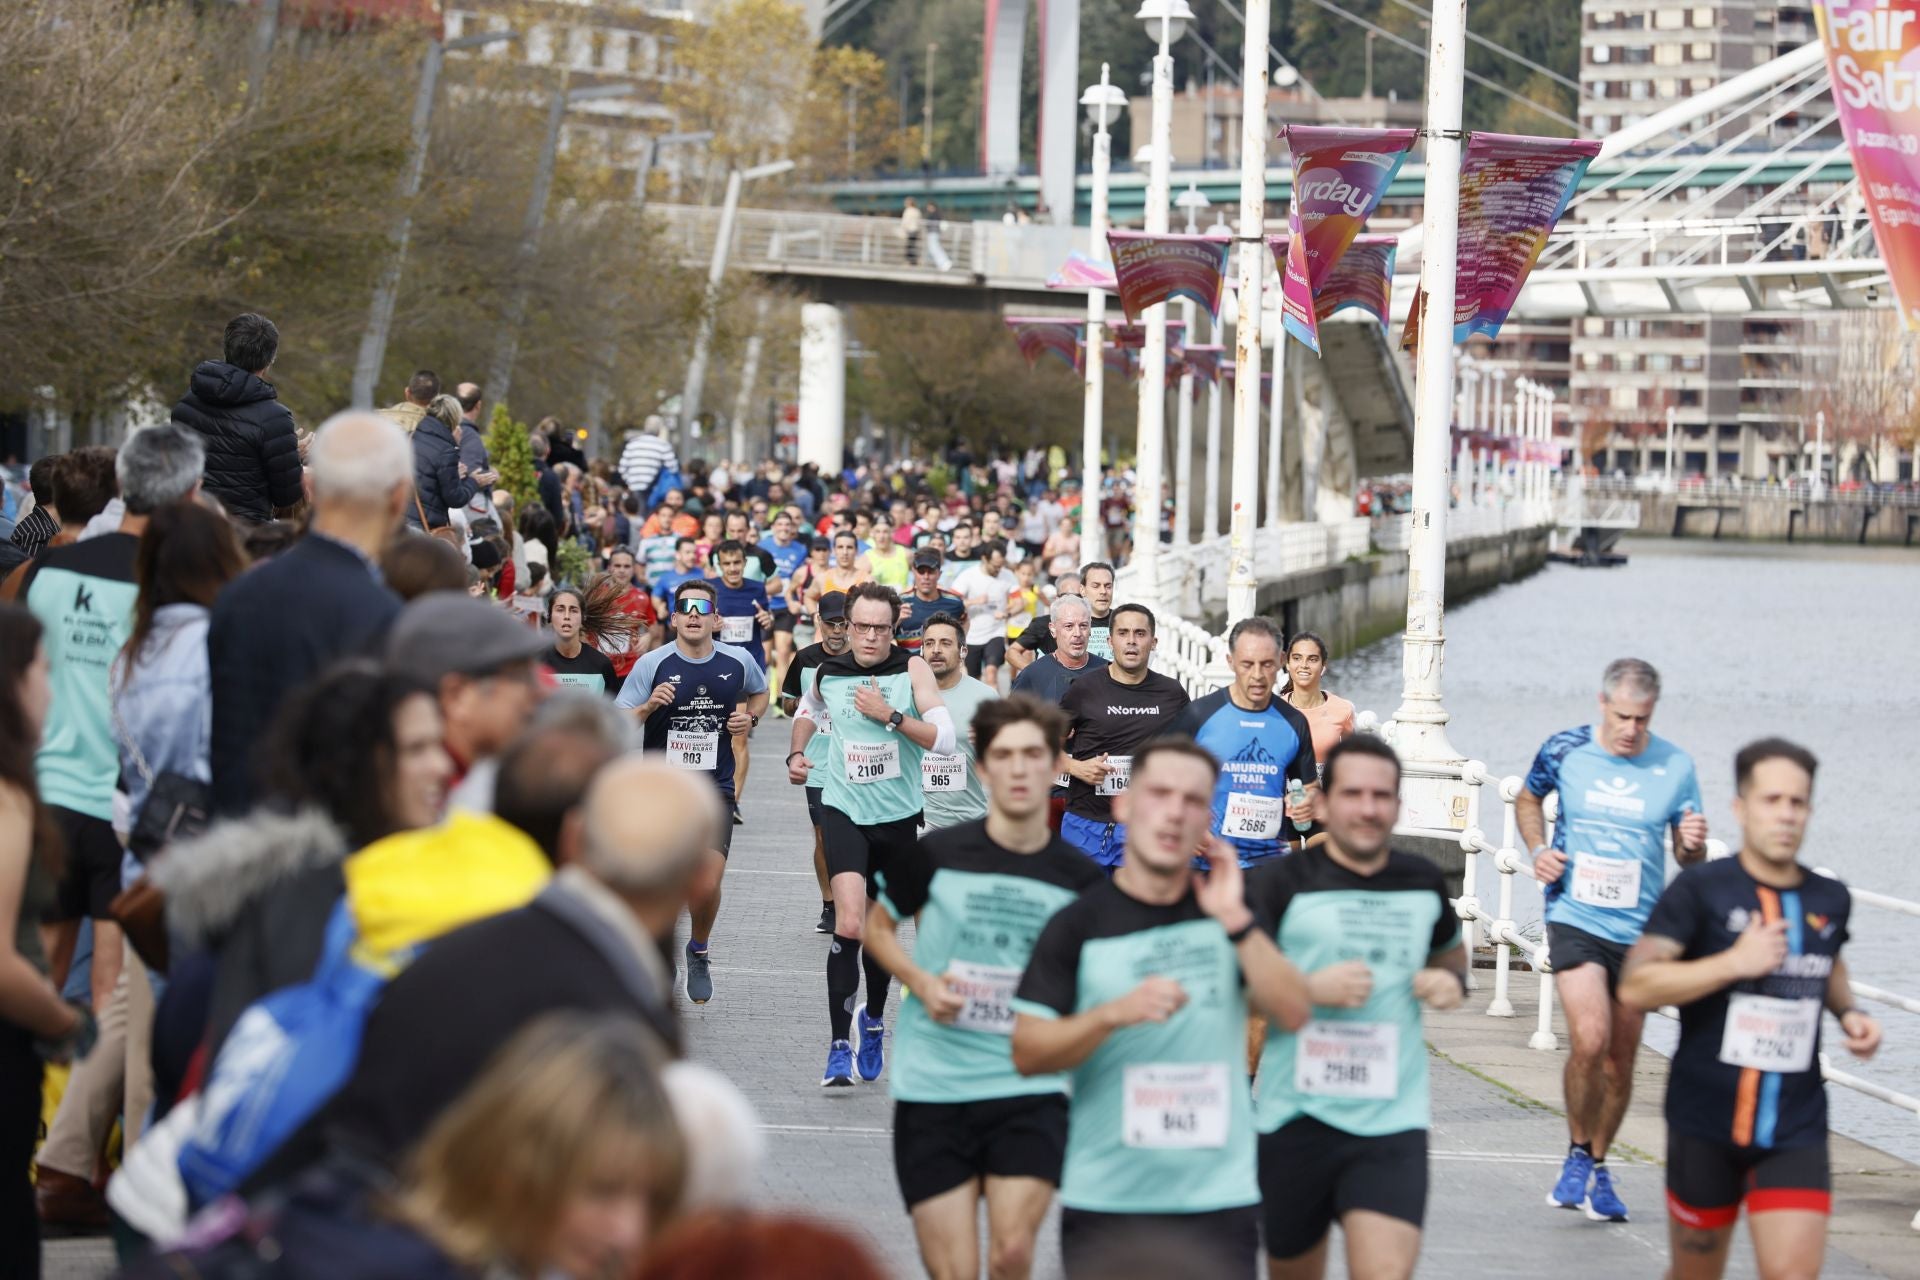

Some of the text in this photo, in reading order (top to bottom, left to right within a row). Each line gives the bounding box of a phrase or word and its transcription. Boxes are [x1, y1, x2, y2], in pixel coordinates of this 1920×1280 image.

[1825, 0, 1916, 52] Fair
[75, 583, 93, 611] k
[670, 741, 691, 751] XXXVI
[683, 752, 701, 764] 803
[847, 753, 868, 764] XXXVI
[857, 763, 885, 778] 2100
[1221, 762, 1279, 775] AMURRIO
[931, 774, 950, 786] 965
[1231, 773, 1266, 784] TRAIL
[1239, 818, 1267, 833] 2686
